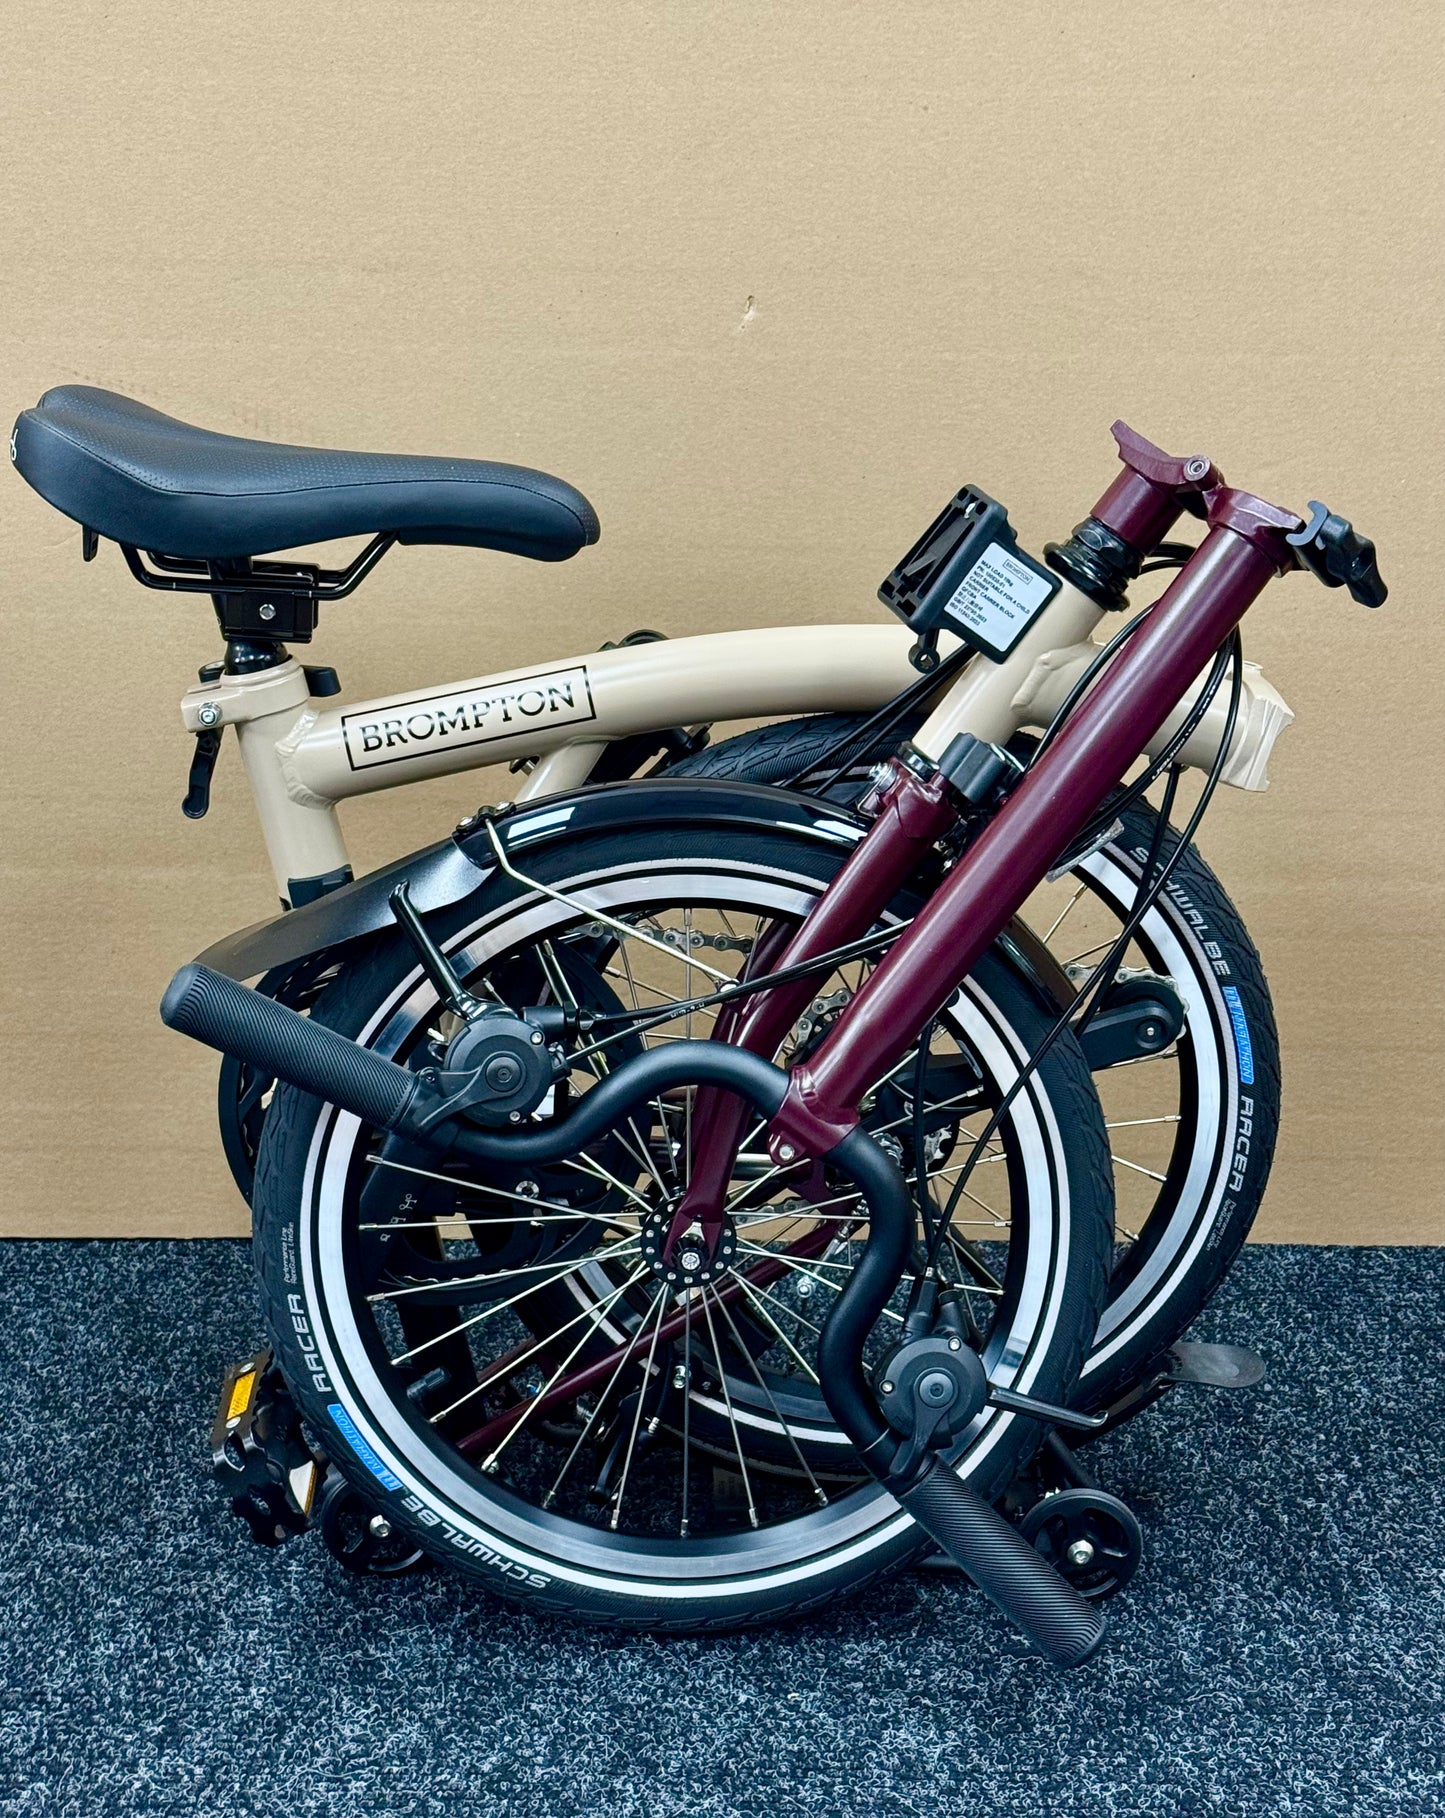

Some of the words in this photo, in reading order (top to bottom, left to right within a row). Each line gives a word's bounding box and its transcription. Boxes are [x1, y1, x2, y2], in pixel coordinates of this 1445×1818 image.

[965, 581, 980, 593] FRONT
[980, 592, 999, 608] CARRIER
[999, 606, 1014, 619] BLOCK
[969, 576, 989, 591] CARRIER
[973, 571, 983, 579] NOT
[983, 578, 1003, 594] SUITABLE
[1003, 592, 1013, 601] FOR
[1016, 602, 1030, 614] CHILD
[981, 560, 991, 569] MAX
[991, 568, 1004, 578] LOAD
[359, 681, 575, 753] BROMPTON
[1230, 1095, 1254, 1193] RACER
[287, 1293, 332, 1393] RACER
[335, 1408, 384, 1473] MARATHON
[401, 1495, 551, 1588] SCHWALBE
